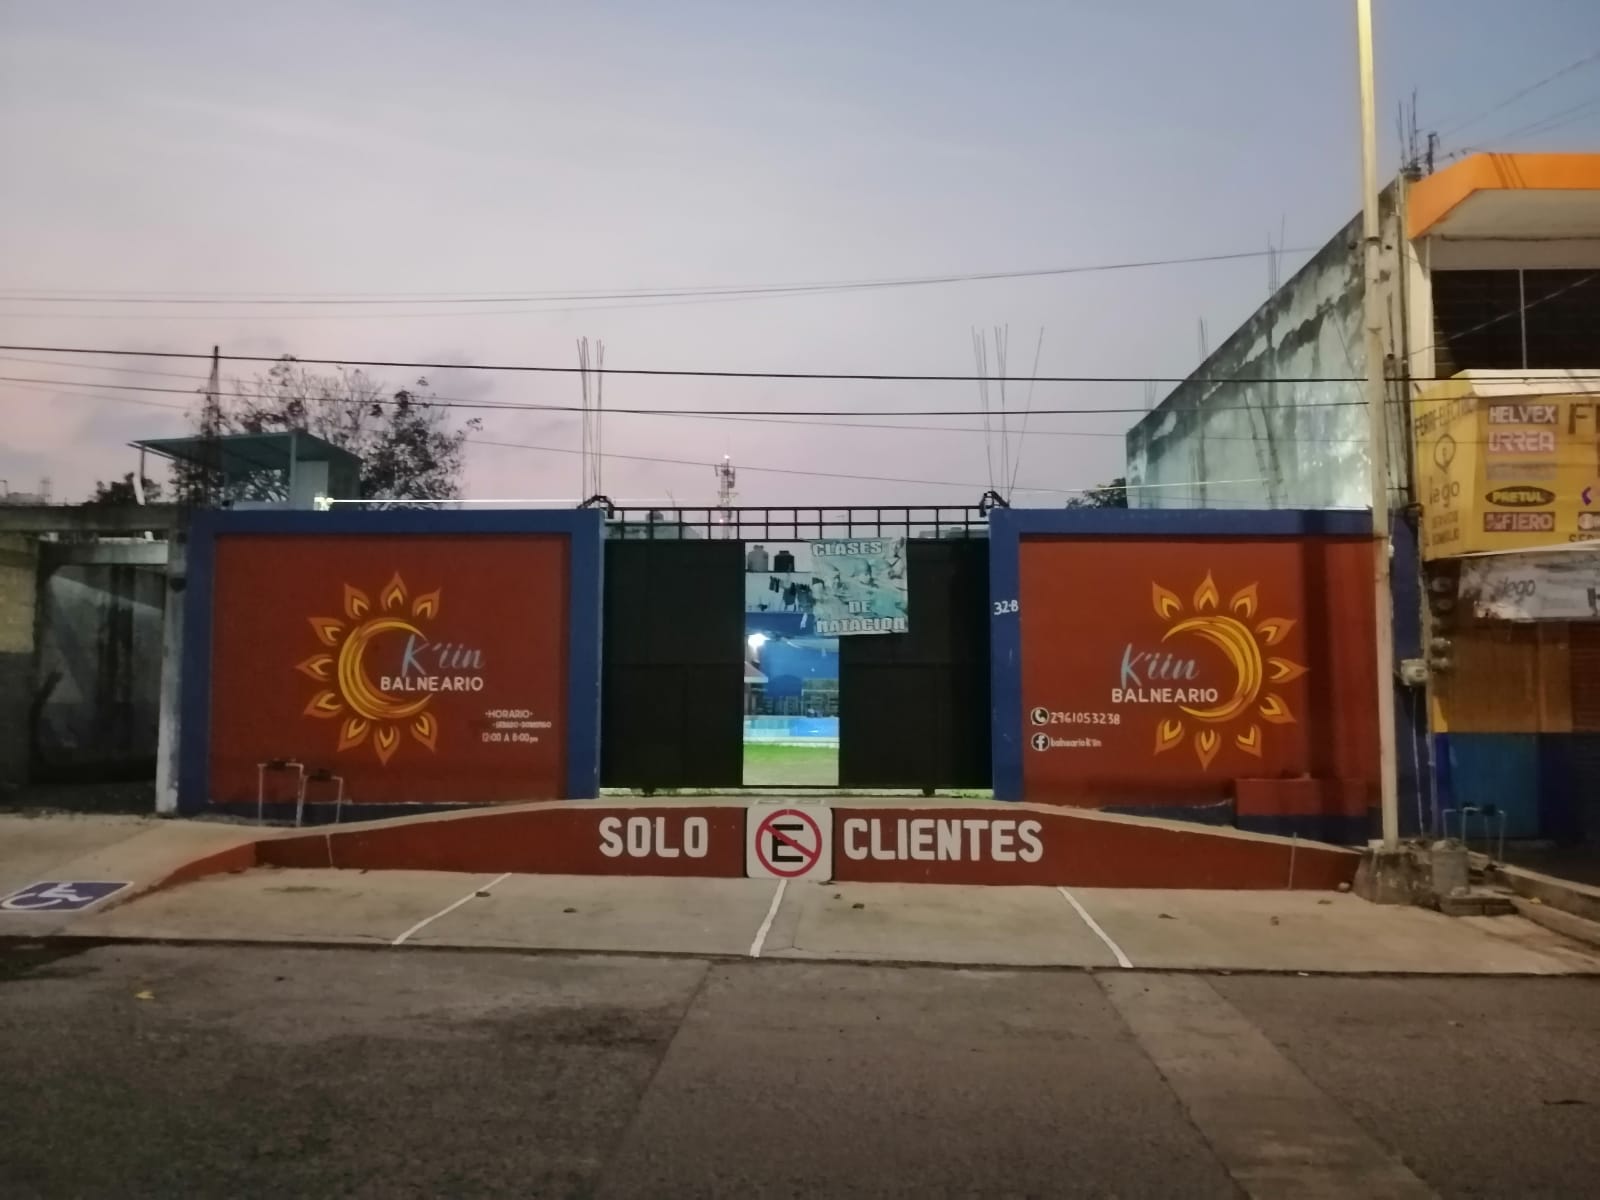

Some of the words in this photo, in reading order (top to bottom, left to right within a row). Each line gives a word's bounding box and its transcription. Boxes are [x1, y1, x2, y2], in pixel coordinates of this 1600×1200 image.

[1489, 405, 1556, 423] HELVEX
[1488, 431, 1555, 452] URREA
[1492, 490, 1546, 503] PRETUL
[812, 541, 882, 557] CLASES
[848, 600, 872, 614] DE
[816, 617, 906, 633] NATACION
[380, 676, 484, 692] BALNEARIO
[1111, 688, 1219, 704] BALNEARIO
[1050, 711, 1121, 725] 2961053238
[504, 733, 510, 742] A
[599, 816, 709, 858] SOLO
[772, 823, 804, 863] E
[843, 818, 1044, 863] CLIENTES
